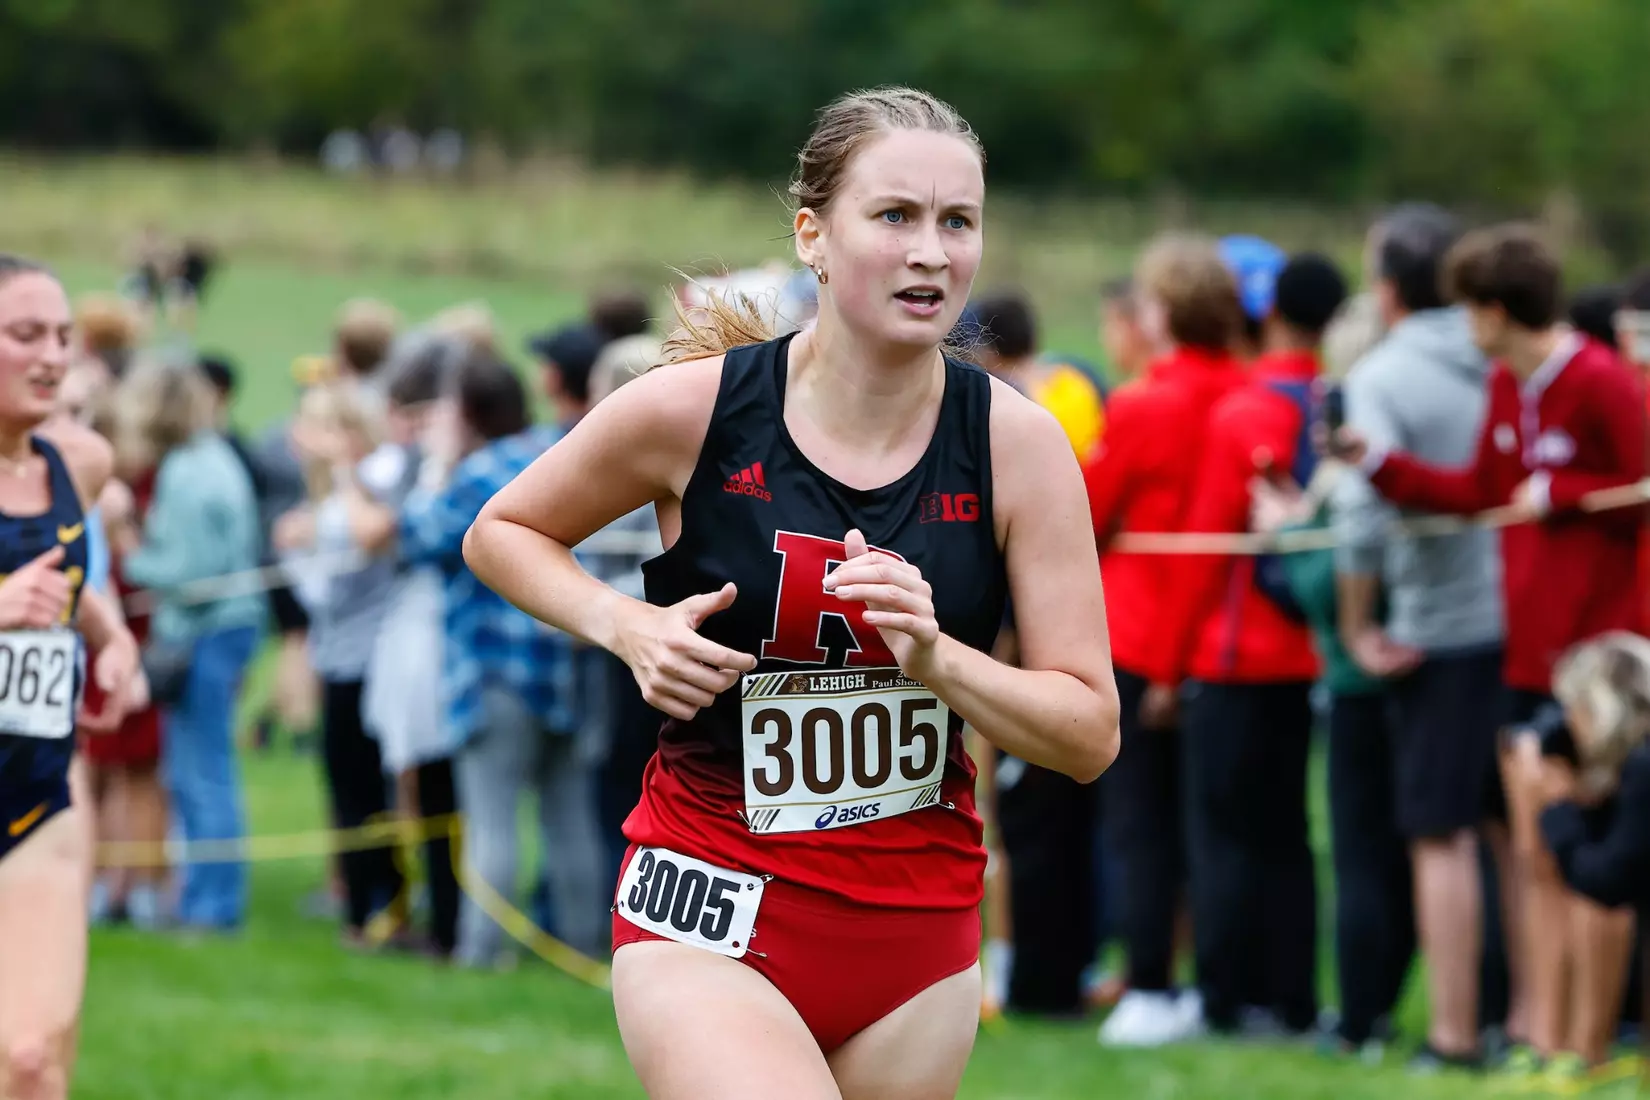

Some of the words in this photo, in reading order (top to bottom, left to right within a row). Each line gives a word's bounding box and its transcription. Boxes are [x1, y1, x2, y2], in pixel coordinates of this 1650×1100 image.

[723, 480, 772, 502] adidas
[809, 674, 866, 691] LEHIGH
[871, 679, 893, 688] Paul
[751, 698, 938, 797] 3005
[627, 851, 741, 941] 3005
